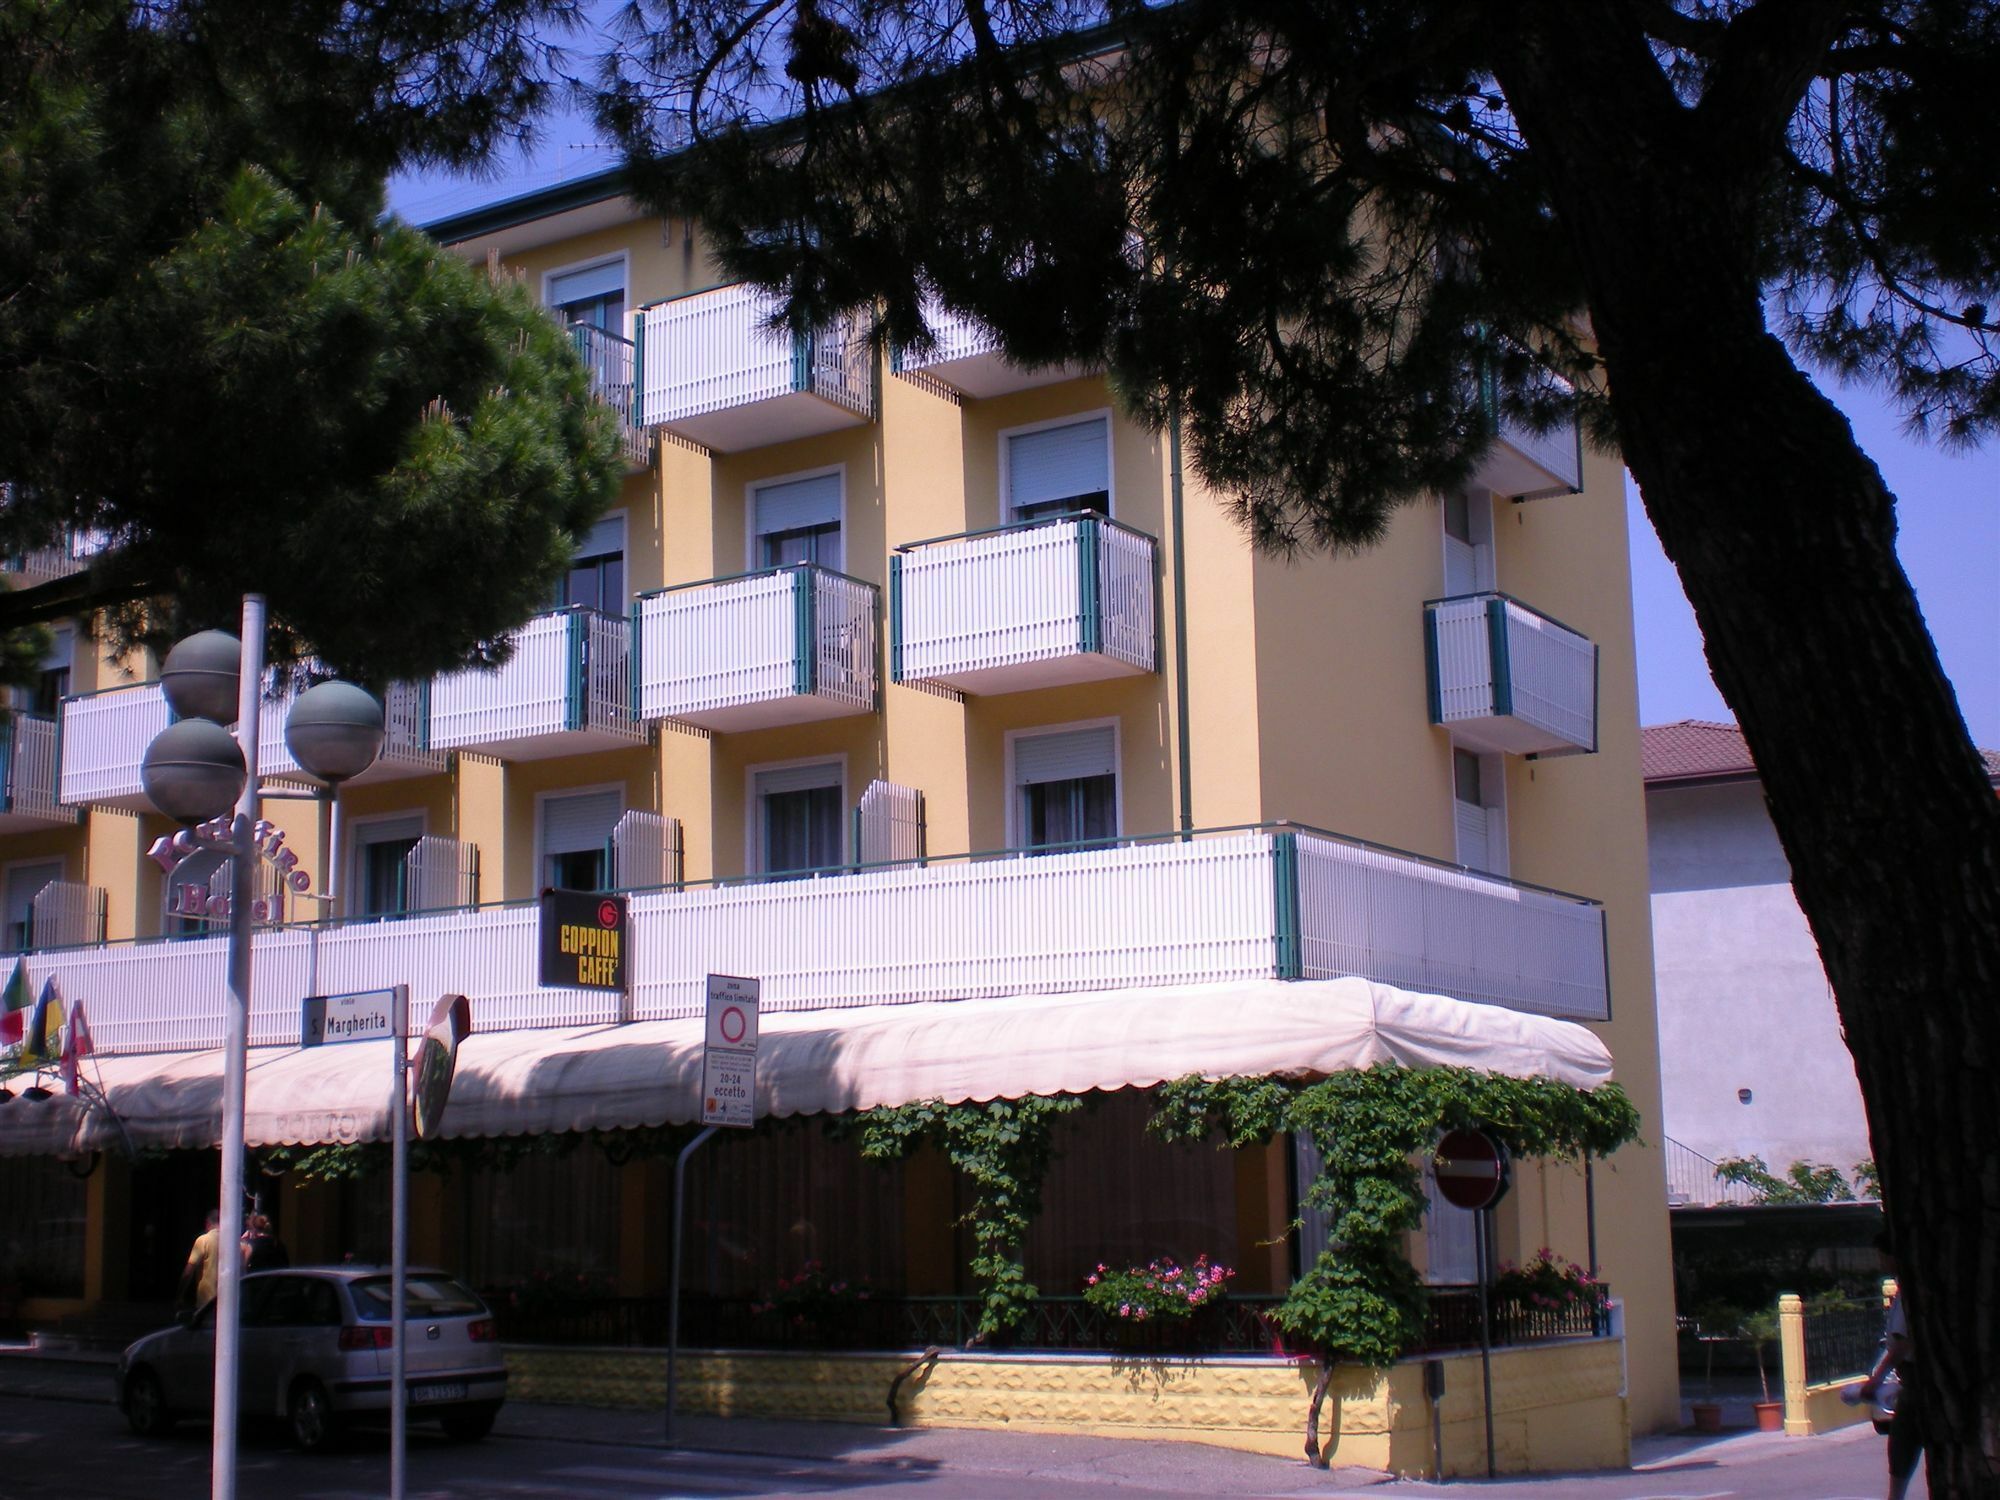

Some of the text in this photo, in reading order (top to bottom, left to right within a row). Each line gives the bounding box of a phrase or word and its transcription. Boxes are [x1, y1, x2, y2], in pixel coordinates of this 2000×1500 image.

[147, 816, 310, 892] Portfino
[176, 884, 284, 921] Hoel
[561, 924, 619, 958] GOPPION
[710, 991, 757, 1004] traffico limitato
[327, 1011, 386, 1036] Margherita
[720, 1073, 741, 1084] 20-24
[714, 1086, 746, 1098] eccetto
